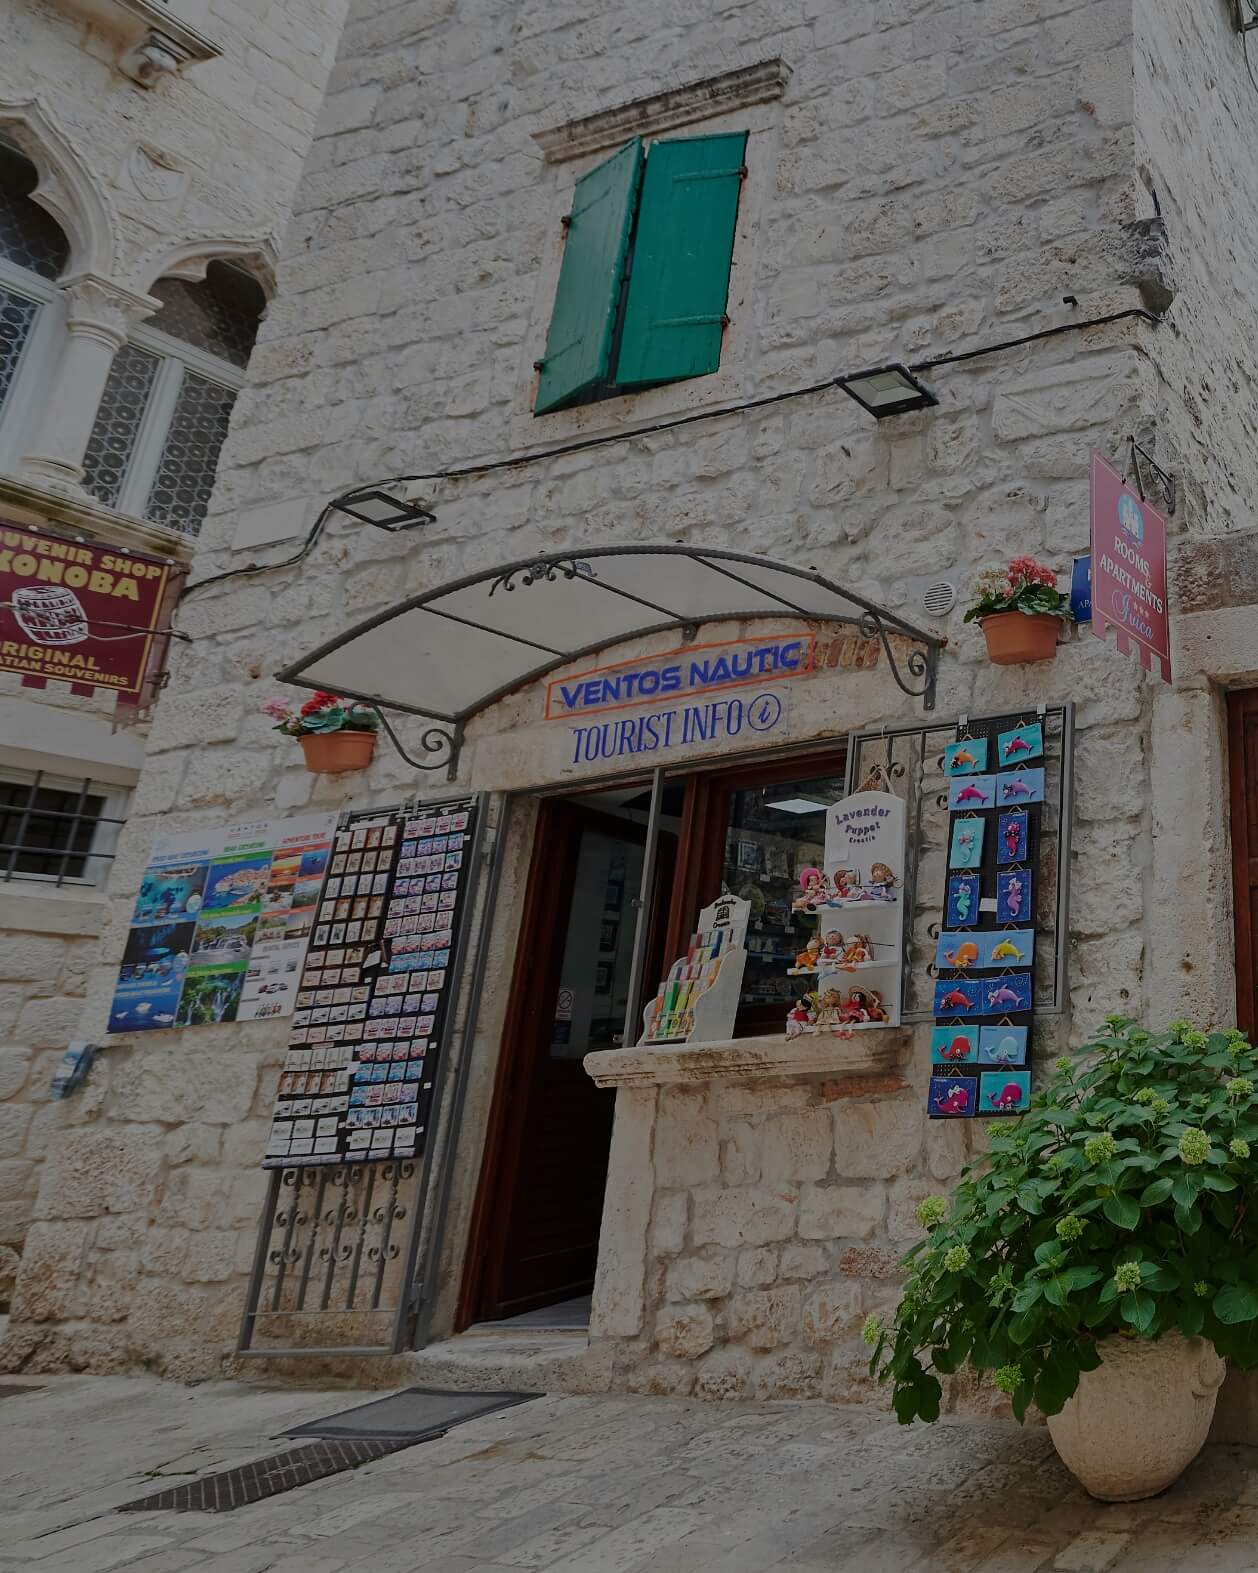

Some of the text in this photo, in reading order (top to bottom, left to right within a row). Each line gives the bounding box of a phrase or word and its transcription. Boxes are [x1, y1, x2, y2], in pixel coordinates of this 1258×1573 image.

[0, 531, 162, 579] UVENIR SHOP
[1114, 535, 1150, 577] ROOMS
[1100, 554, 1163, 615] APARTMENTS
[0, 641, 101, 670] RIGINAL
[44, 663, 128, 686] SOUVENIRS
[560, 642, 801, 708] VENTOS NAUTIC
[572, 711, 677, 764] TOURIST
[681, 699, 743, 744] INFO
[835, 805, 891, 825] Lavender
